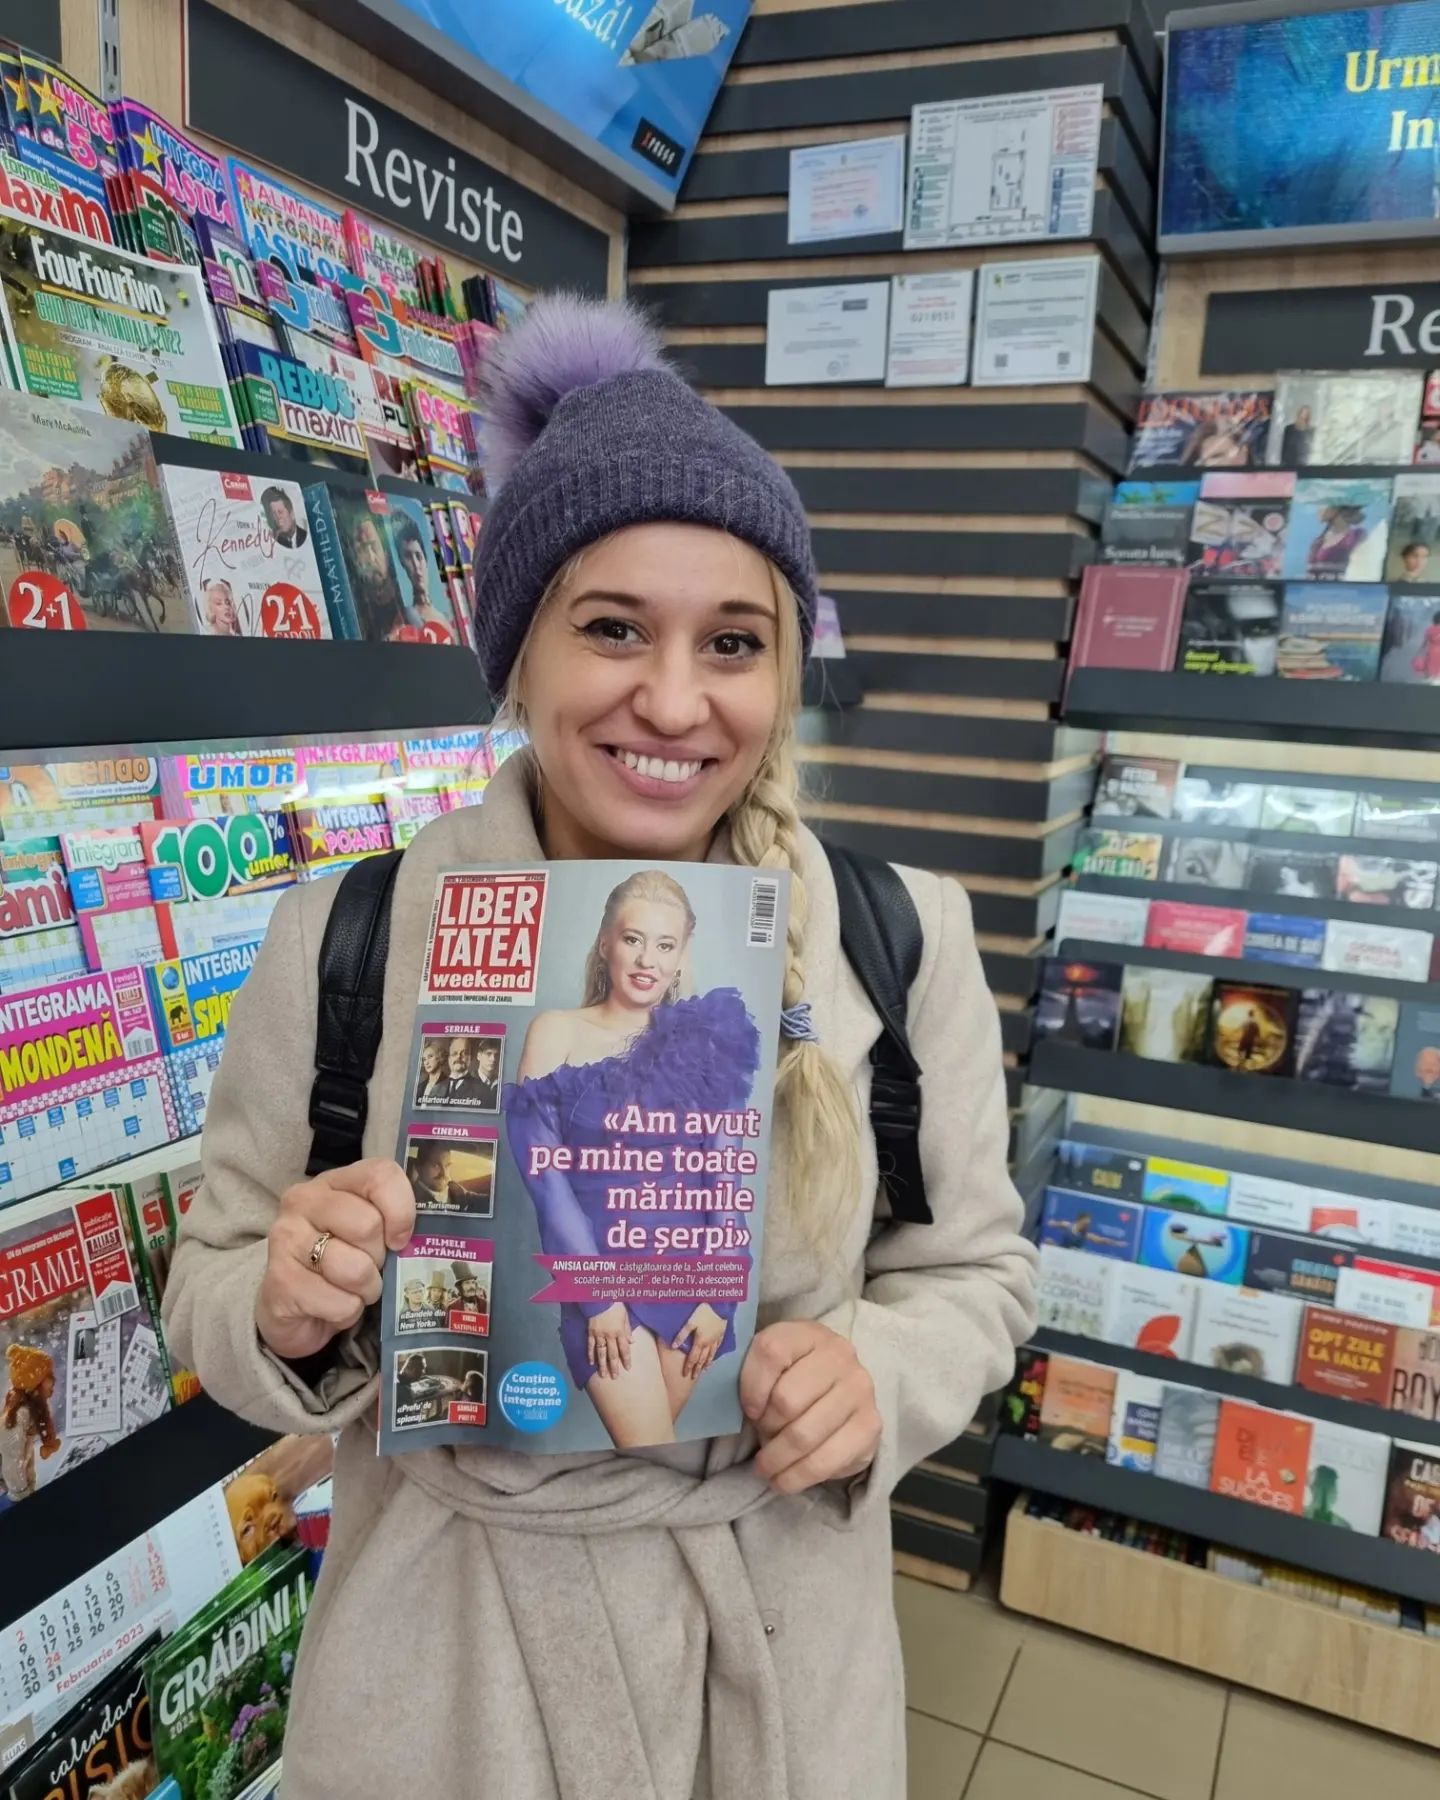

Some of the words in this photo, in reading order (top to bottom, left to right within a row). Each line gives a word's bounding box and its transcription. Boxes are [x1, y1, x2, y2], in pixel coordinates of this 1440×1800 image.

[345, 98, 524, 263] Reviste
[30, 235, 166, 316] FourFourTwo
[259, 351, 358, 420] REBUS
[283, 403, 364, 452] maxim
[18, 581, 73, 630] 2+1
[266, 594, 314, 632] 2+1
[190, 763, 295, 789] UMOR
[440, 885, 538, 926] LIBER
[438, 927, 532, 968] TATEA
[432, 969, 532, 989] weekend
[444, 1025, 481, 1034] SERIALE
[0, 1011, 123, 1092] MONDENĂ
[431, 1126, 470, 1137] CINEMA
[604, 1105, 677, 1134] «Am
[684, 1109, 760, 1137] avut
[530, 1145, 572, 1175] pe
[579, 1142, 664, 1173] mine
[672, 1146, 757, 1173] toate
[607, 1182, 753, 1211] mărimile
[93, 1230, 116, 1250] ALIAS
[413, 1246, 477, 1260] SĂPTĂMÂNII
[425, 1237, 467, 1249] FILMELE
[607, 1219, 646, 1249] de
[654, 1220, 751, 1256] șerpi»
[552, 1261, 582, 1272] ANISIA
[673, 1262, 683, 1272] de
[683, 1262, 691, 1272] la
[574, 1274, 616, 1285] scoate-mă
[616, 1275, 627, 1285] de
[651, 1275, 662, 1285] de
[662, 1275, 670, 1285] la
[670, 1275, 685, 1285] Pro
[704, 1275, 744, 1286] descoperit
[600, 1287, 625, 1300] junglă
[625, 1287, 636, 1298] că
[636, 1289, 642, 1298] e
[642, 1287, 658, 1298] mai
[658, 1287, 695, 1301] puternică
[695, 1287, 718, 1298] decât
[718, 1287, 744, 1298] credea
[400, 1321, 416, 1330] New
[434, 1309, 446, 1317] din
[1307, 1343, 1331, 1363] LA
[1309, 1328, 1345, 1347] OPT
[1346, 1336, 1386, 1358] ZILE
[506, 1383, 561, 1397] horoscop,
[511, 1373, 557, 1386] Conține
[422, 1401, 432, 1409] de
[503, 1393, 562, 1408] integrame
[1219, 1475, 1294, 1512] SUCCES
[16, 1630, 26, 1644] 2
[39, 1614, 49, 1627] 3
[62, 1599, 71, 1611] 4
[85, 1583, 93, 1597] 5
[106, 1570, 114, 1582] 6
[19, 1643, 28, 1656] 9
[40, 1624, 56, 1642] 10
[62, 1610, 77, 1626] 11
[85, 1594, 100, 1611] 12
[106, 1580, 121, 1597] 13
[149, 1553, 161, 1566] 15
[19, 1655, 36, 1673] 16
[43, 1638, 58, 1655] 17
[66, 1622, 81, 1640] 18
[88, 1607, 103, 1624] 19
[109, 1593, 124, 1611] 20
[150, 1565, 164, 1580] 22
[22, 1667, 39, 1687] 23
[45, 1652, 62, 1670] 24
[68, 1635, 84, 1654] 25
[90, 1621, 106, 1639] 26
[111, 1606, 126, 1624] 27
[152, 1578, 166, 1593] 29
[56, 1647, 114, 1694] Februarie
[115, 1623, 145, 1650] 2023
[160, 1584, 292, 1726] GRĂDINI
[24, 1680, 42, 1700] 30
[48, 1665, 63, 1683] 31
